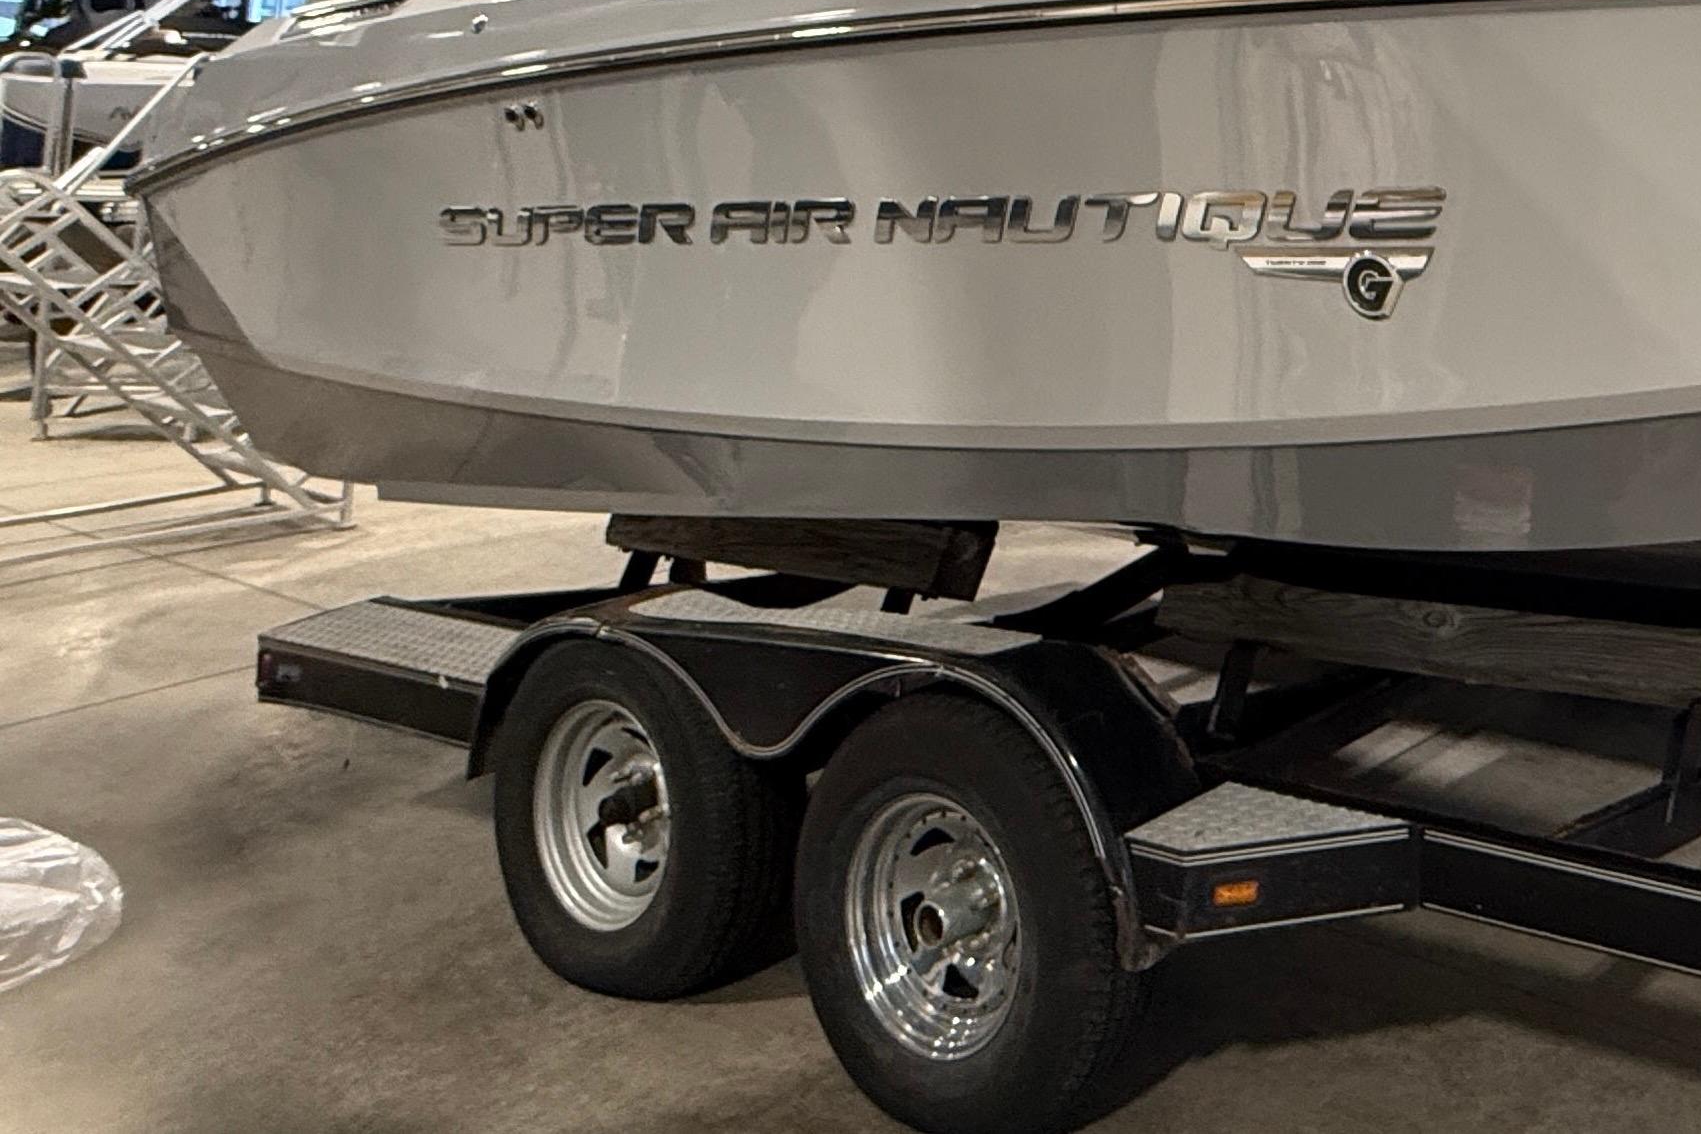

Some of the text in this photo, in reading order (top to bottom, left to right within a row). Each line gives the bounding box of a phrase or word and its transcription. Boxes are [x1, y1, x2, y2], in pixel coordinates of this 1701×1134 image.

[438, 185, 1447, 250] SUPER AIR NAUTIQUE
